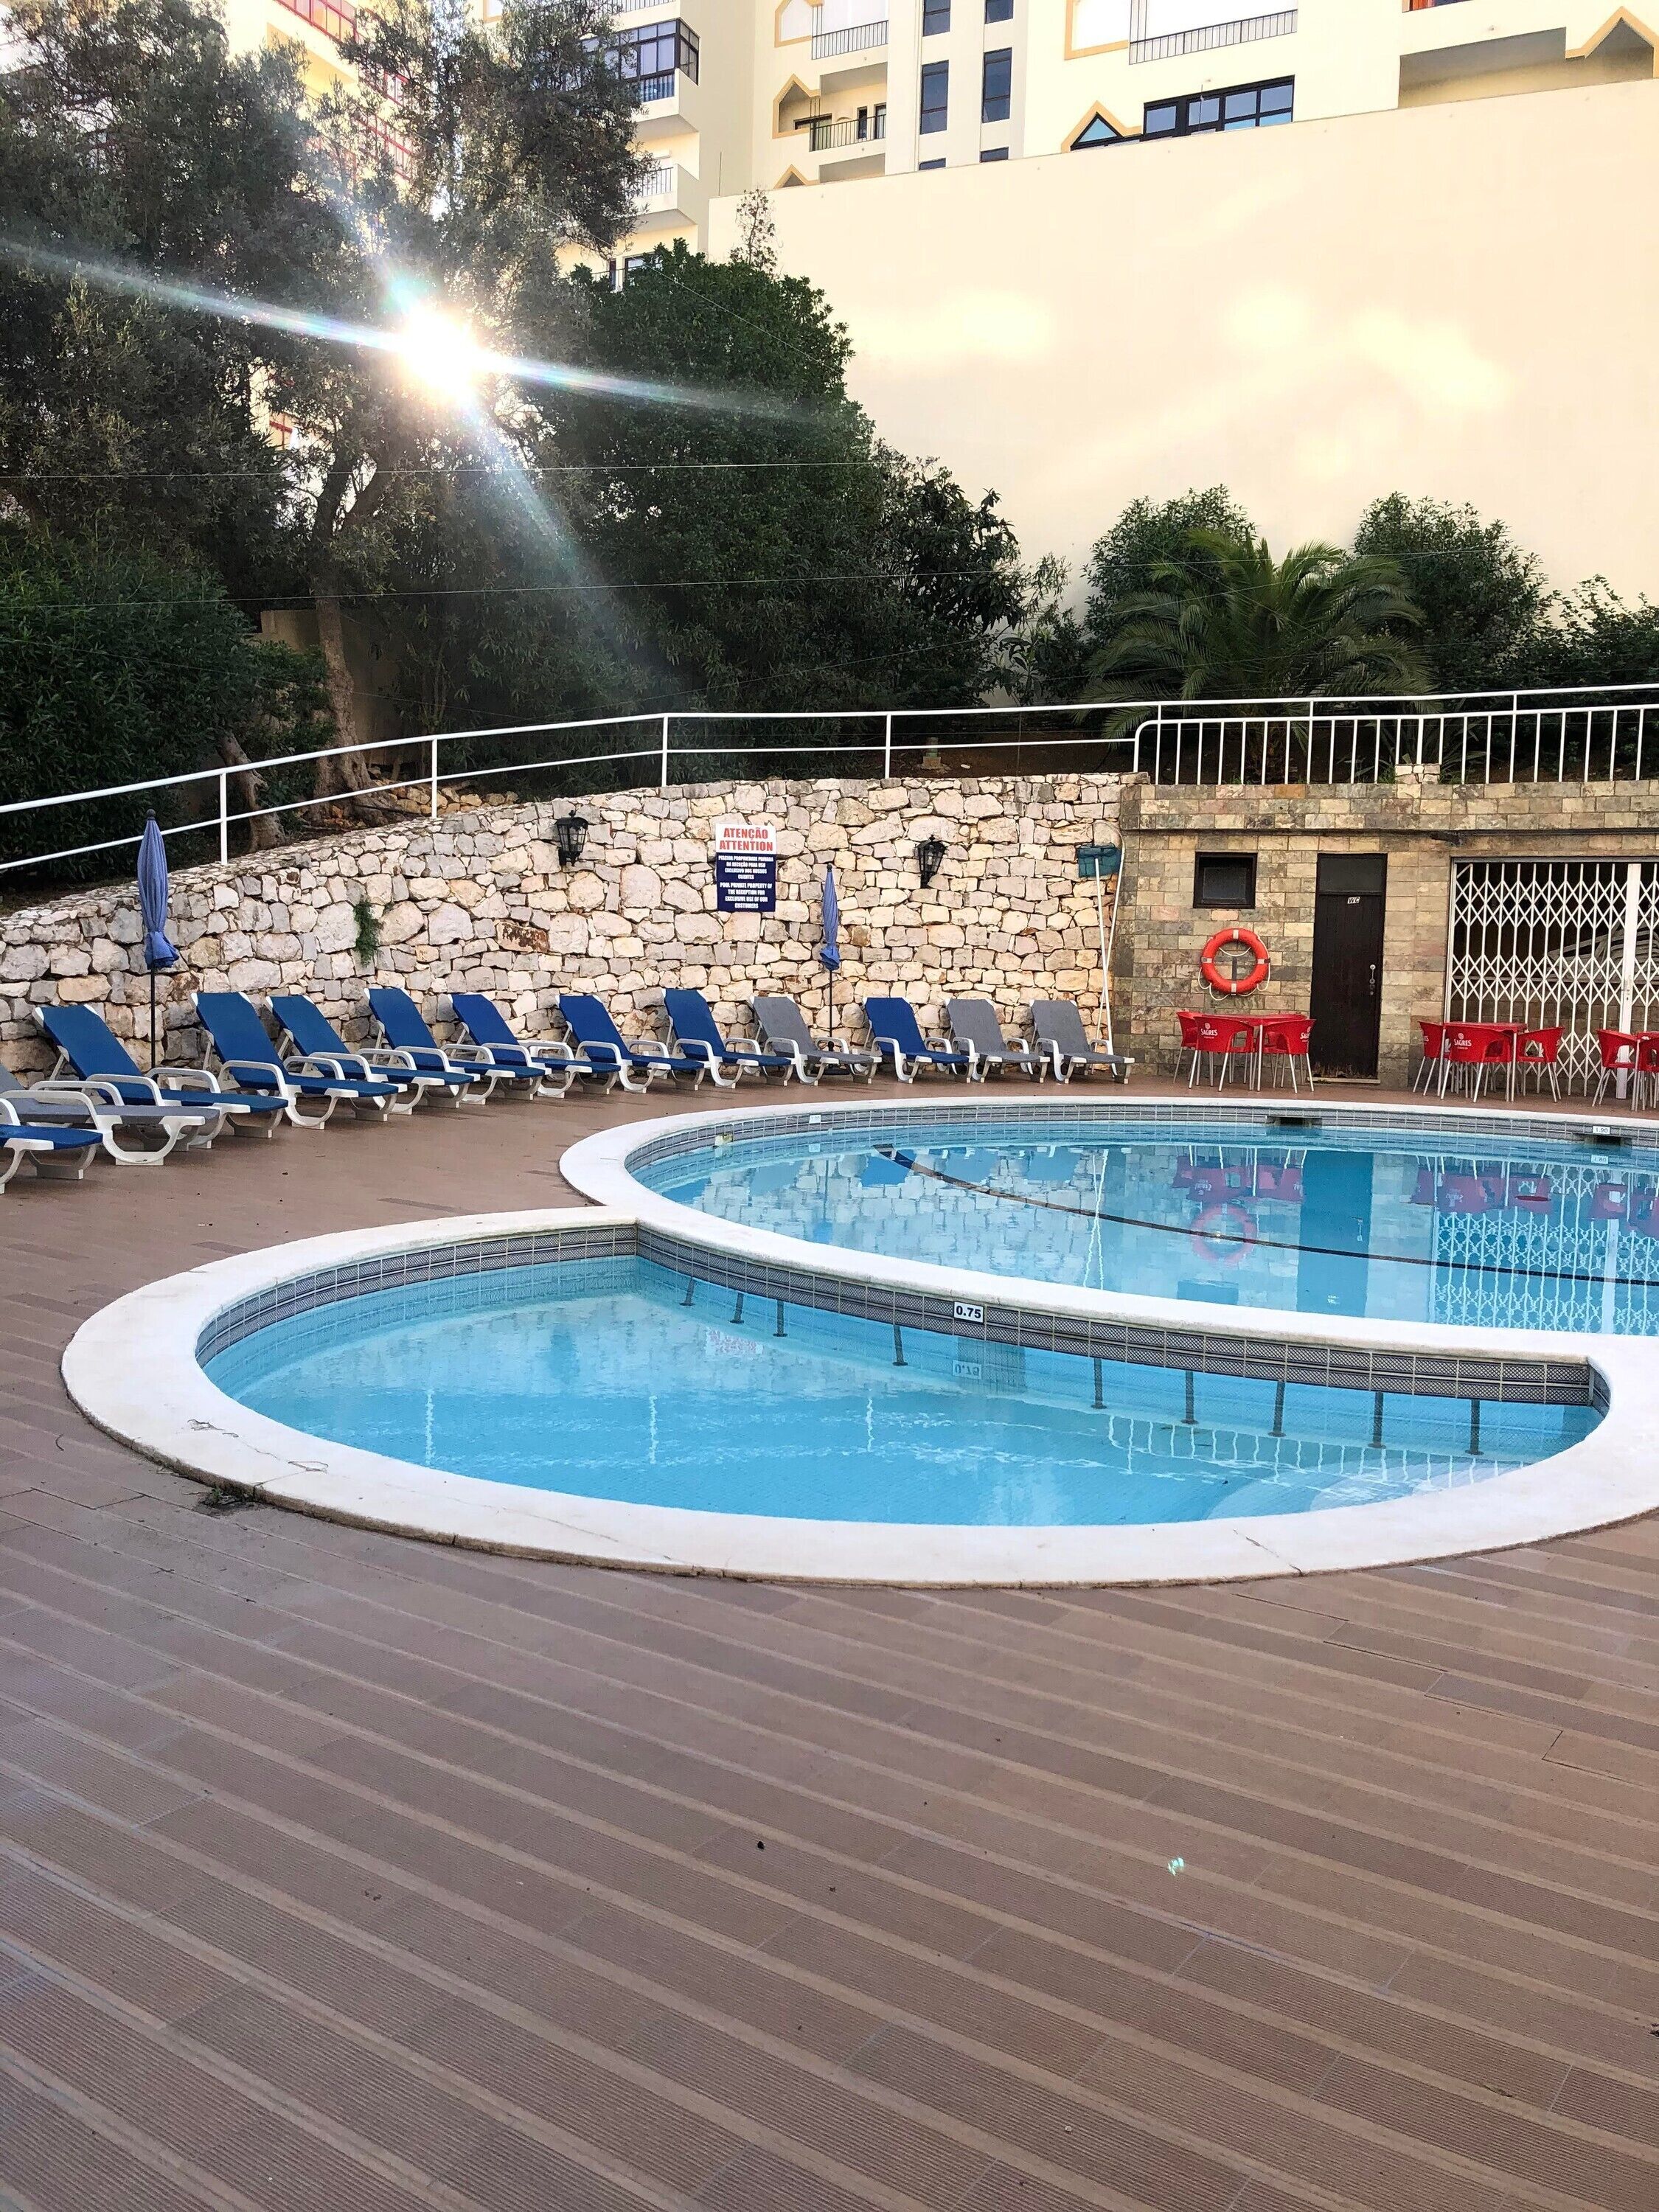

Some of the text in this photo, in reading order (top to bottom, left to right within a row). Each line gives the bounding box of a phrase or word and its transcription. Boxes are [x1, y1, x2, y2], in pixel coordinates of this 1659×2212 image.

[723, 827, 768, 840] ATENÇÃO
[719, 840, 773, 851] ATTENTION
[956, 1305, 981, 1318] 0.75
